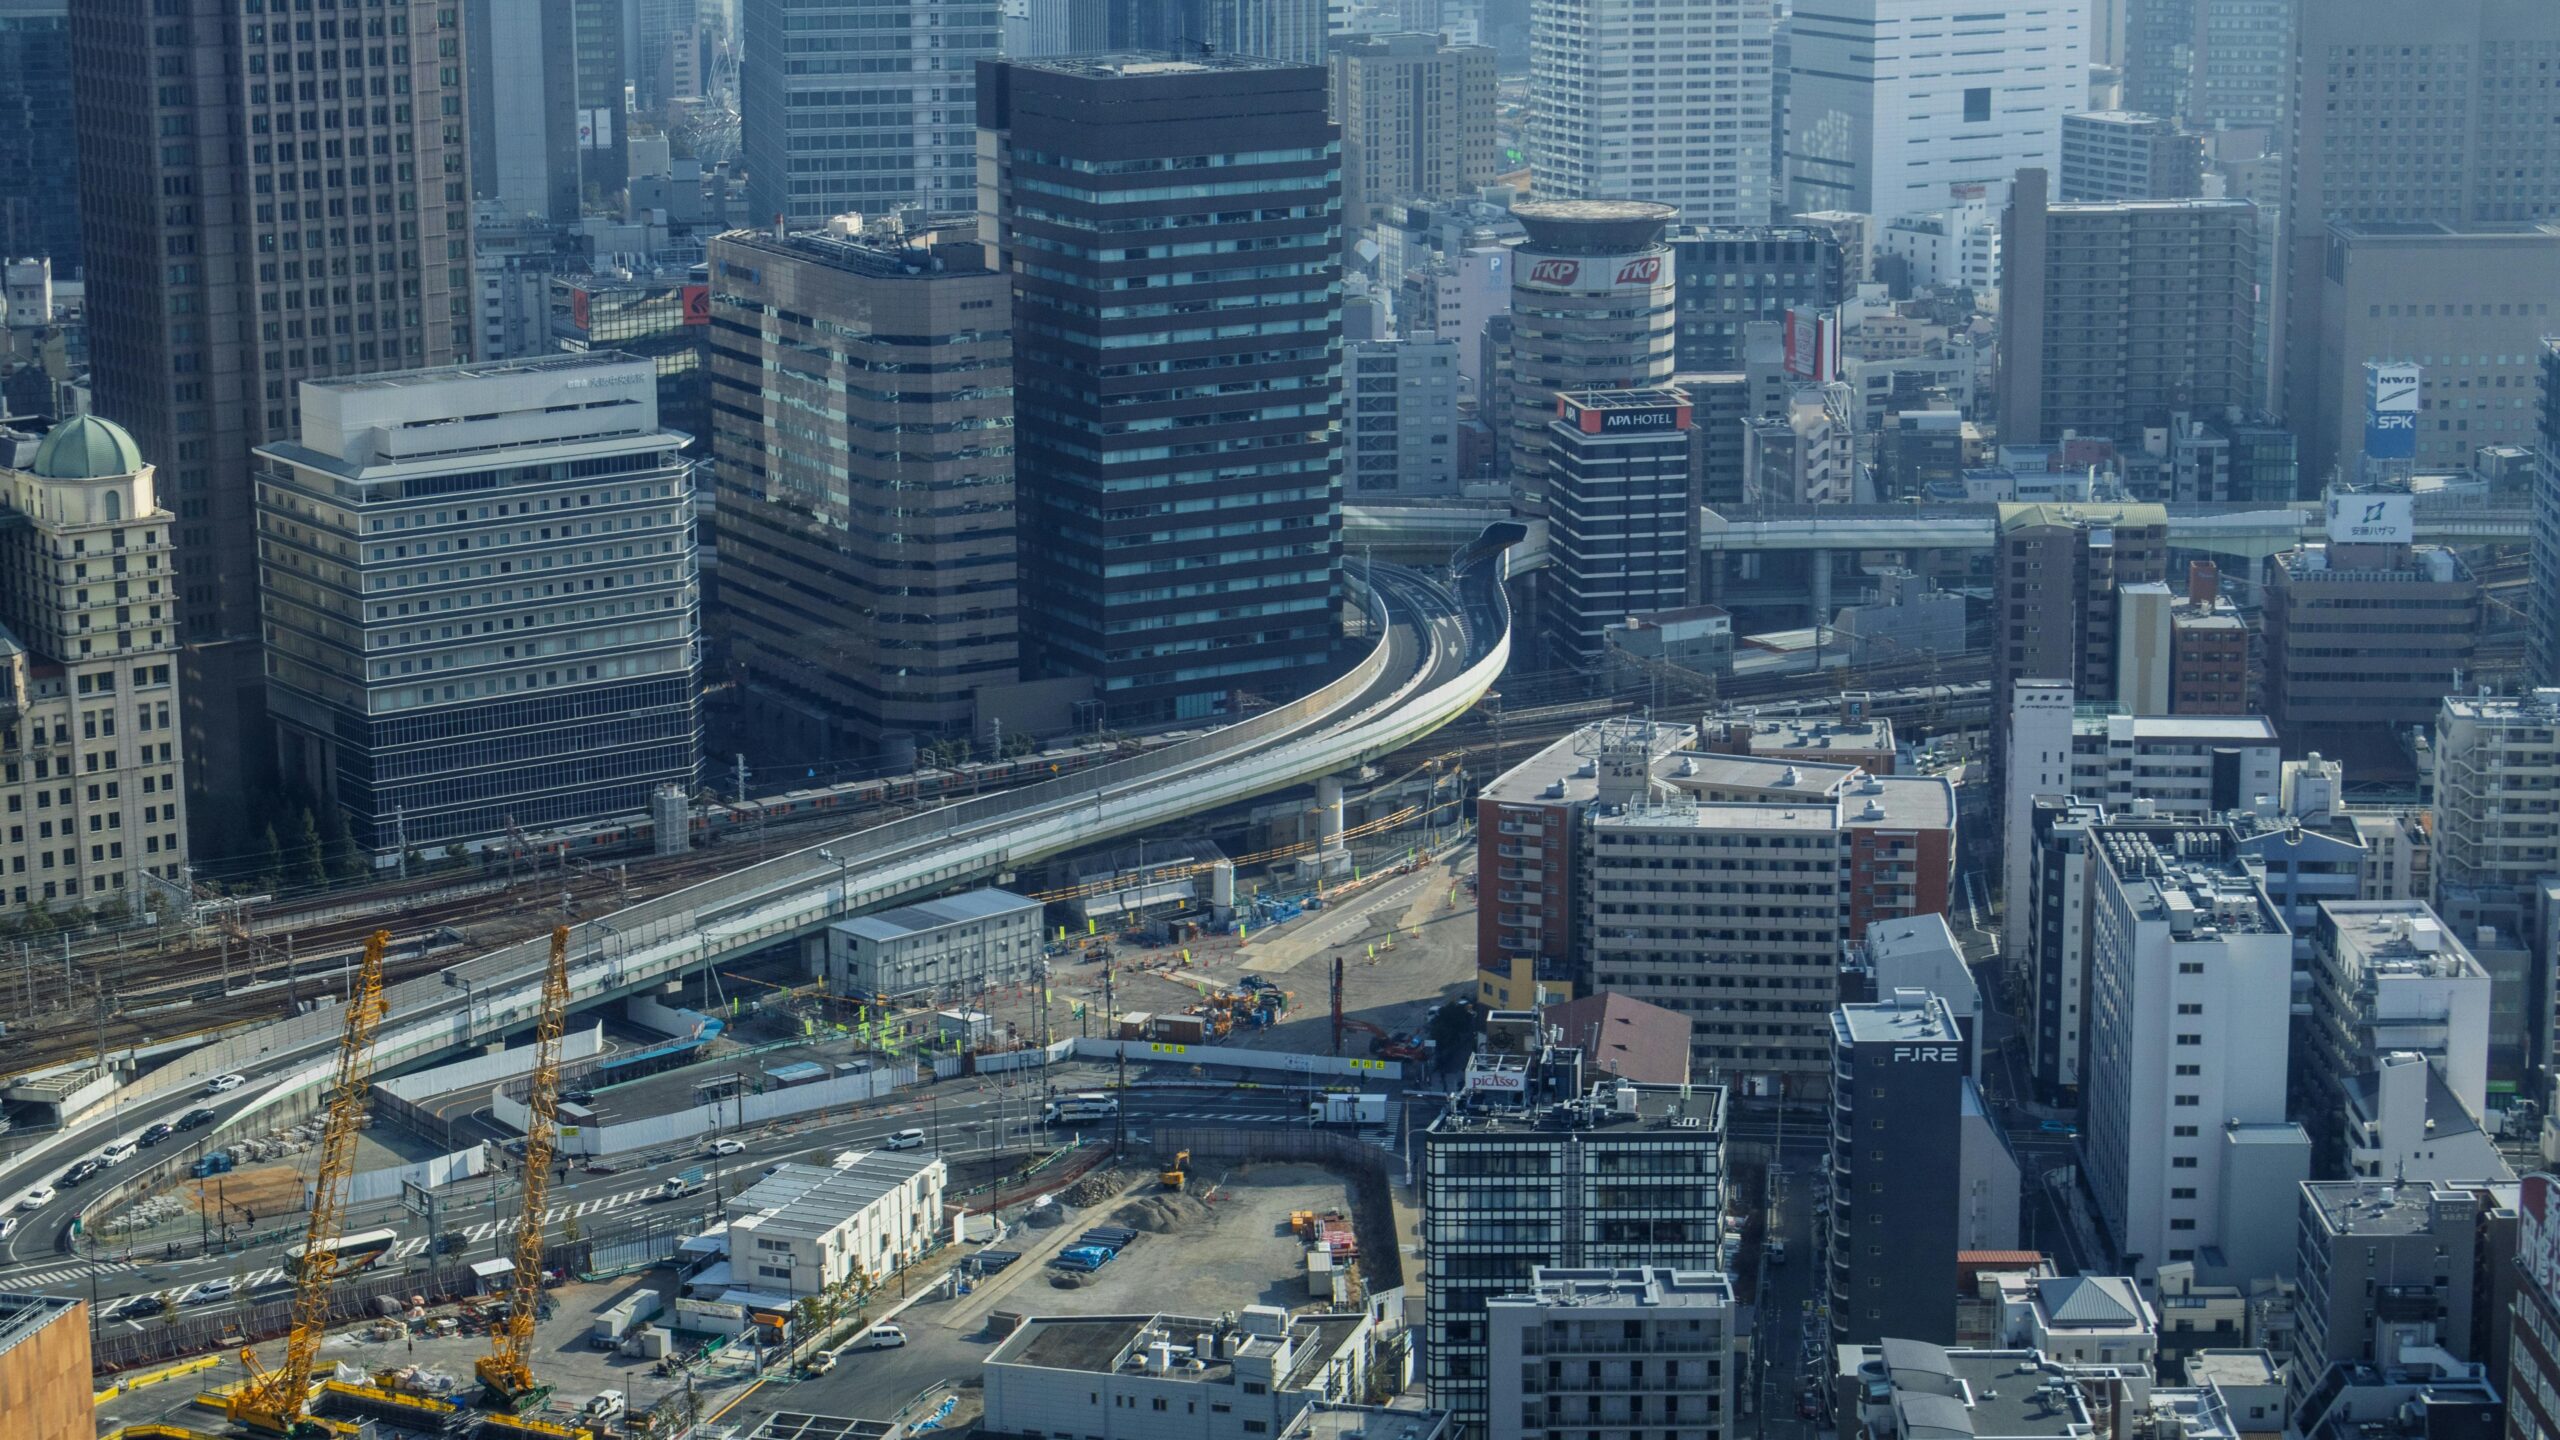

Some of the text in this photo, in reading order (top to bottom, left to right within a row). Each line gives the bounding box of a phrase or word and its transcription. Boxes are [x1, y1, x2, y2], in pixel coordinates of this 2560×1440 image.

[1534, 262, 1576, 281] TKP
[1622, 259, 1660, 281] TKP
[2380, 376, 2417, 385] NWB
[1607, 413, 1672, 426] APA HOTEL
[2378, 415, 2414, 429] SPK
